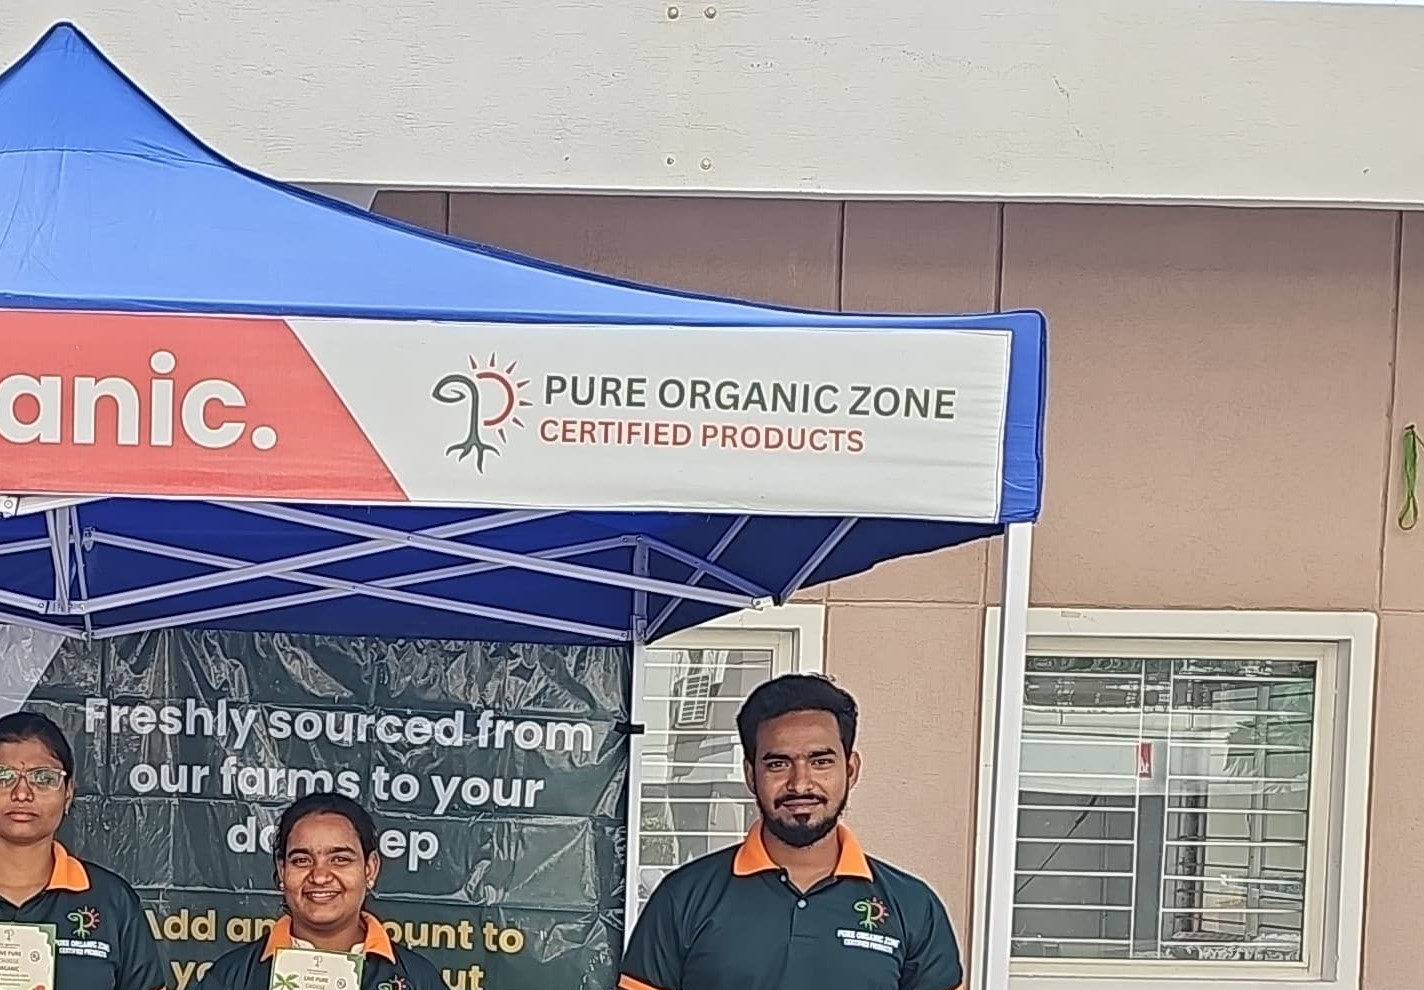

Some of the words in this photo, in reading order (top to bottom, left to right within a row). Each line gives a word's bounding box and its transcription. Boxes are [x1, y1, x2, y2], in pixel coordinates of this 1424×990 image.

[544, 375, 647, 408] PURE
[658, 378, 840, 416] ORGANIC
[848, 385, 956, 419] ZONE
[539, 418, 692, 448] CERTIFIED
[700, 424, 865, 454] PRODUCTS
[84, 698, 259, 749] Freshly
[267, 710, 466, 747] sourced
[476, 709, 594, 751] from
[129, 763, 210, 794] our
[220, 756, 361, 799] farms
[372, 765, 421, 802] to
[430, 774, 545, 815] your
[482, 922, 525, 954] to
